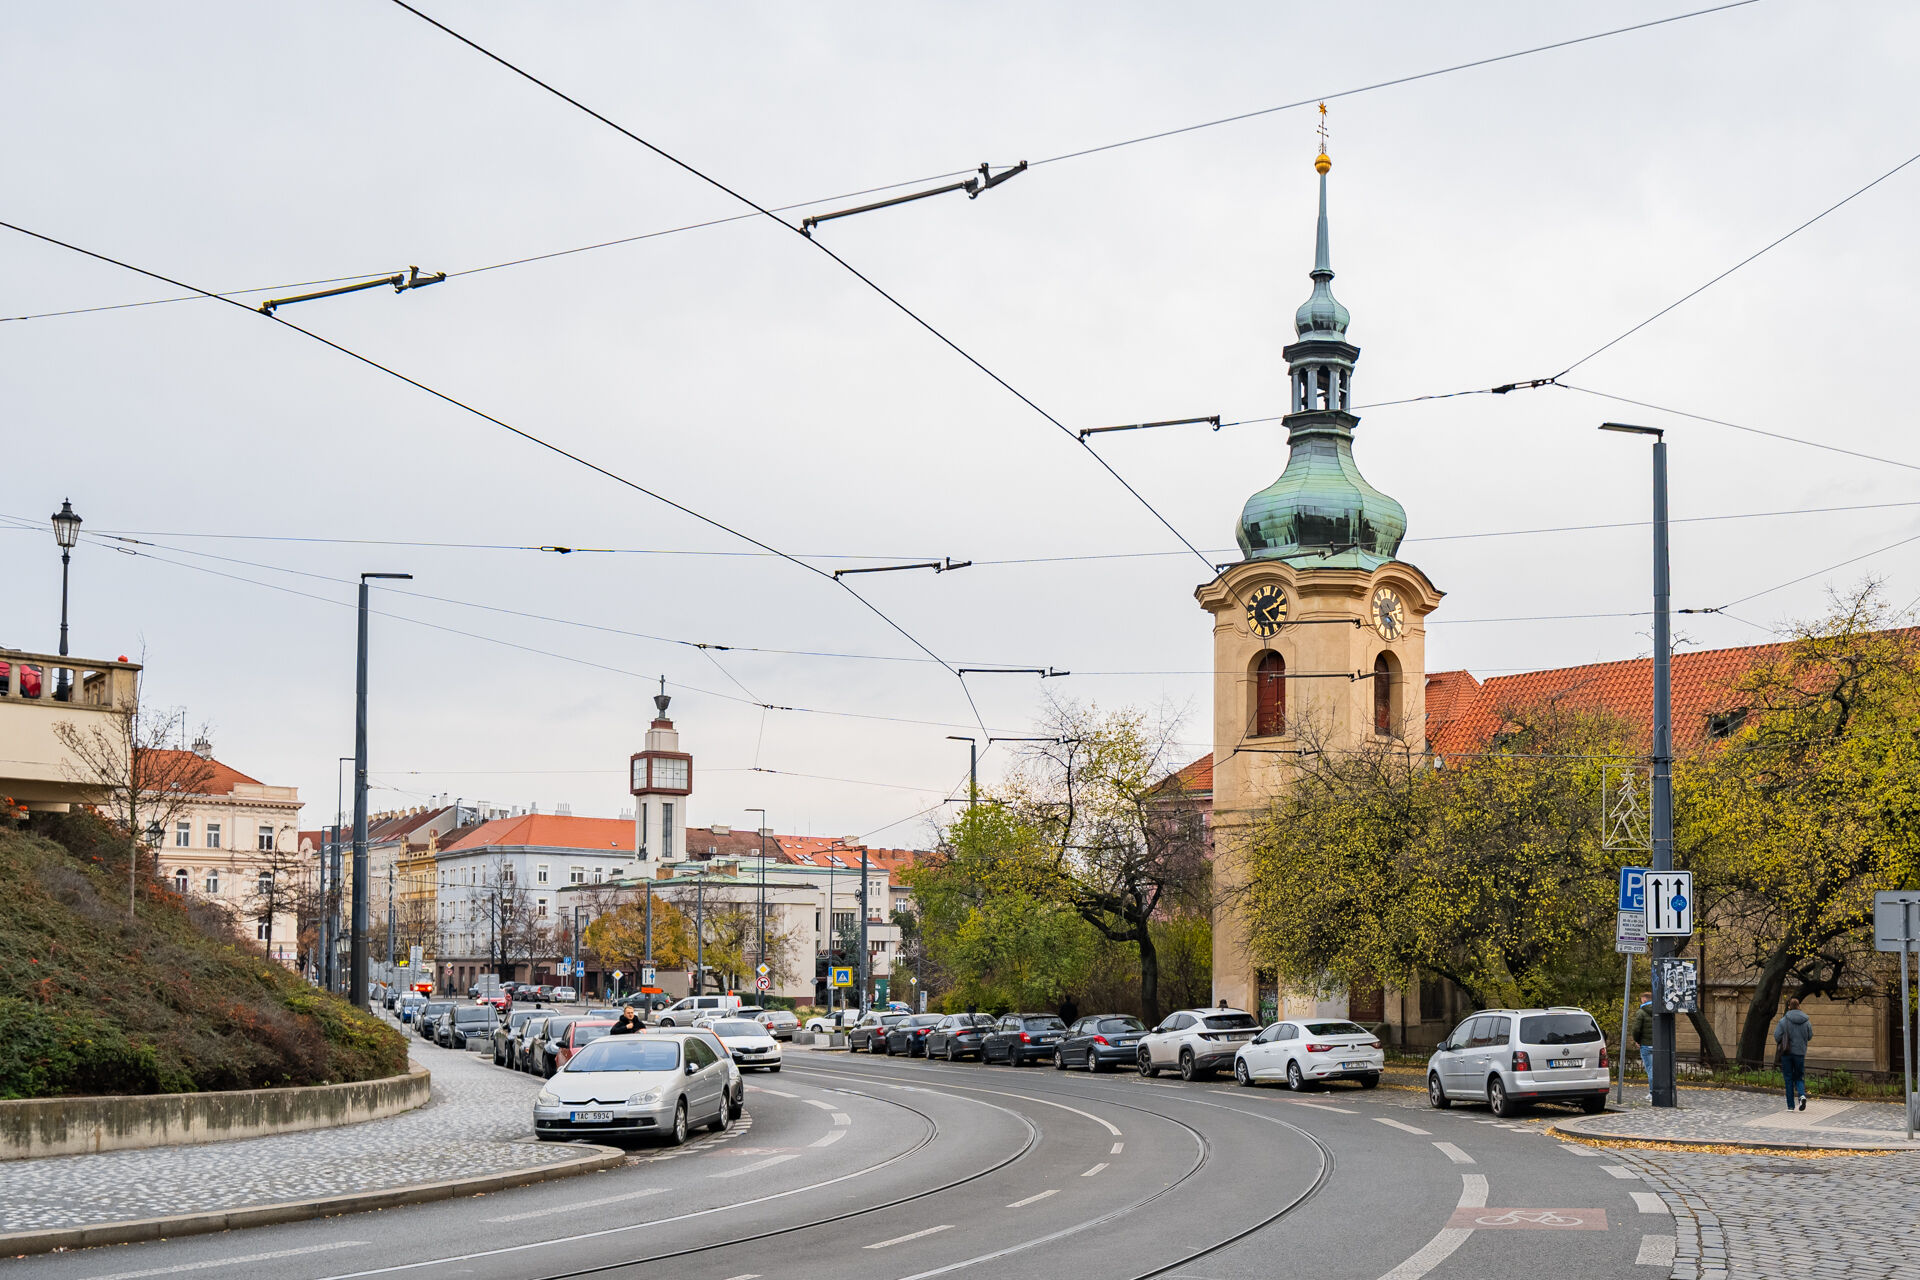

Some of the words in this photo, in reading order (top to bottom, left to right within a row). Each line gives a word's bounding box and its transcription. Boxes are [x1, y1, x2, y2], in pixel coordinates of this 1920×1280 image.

[1627, 873, 1644, 897] P
[577, 1112, 589, 1120] 1AC
[593, 1112, 610, 1120] 5934
